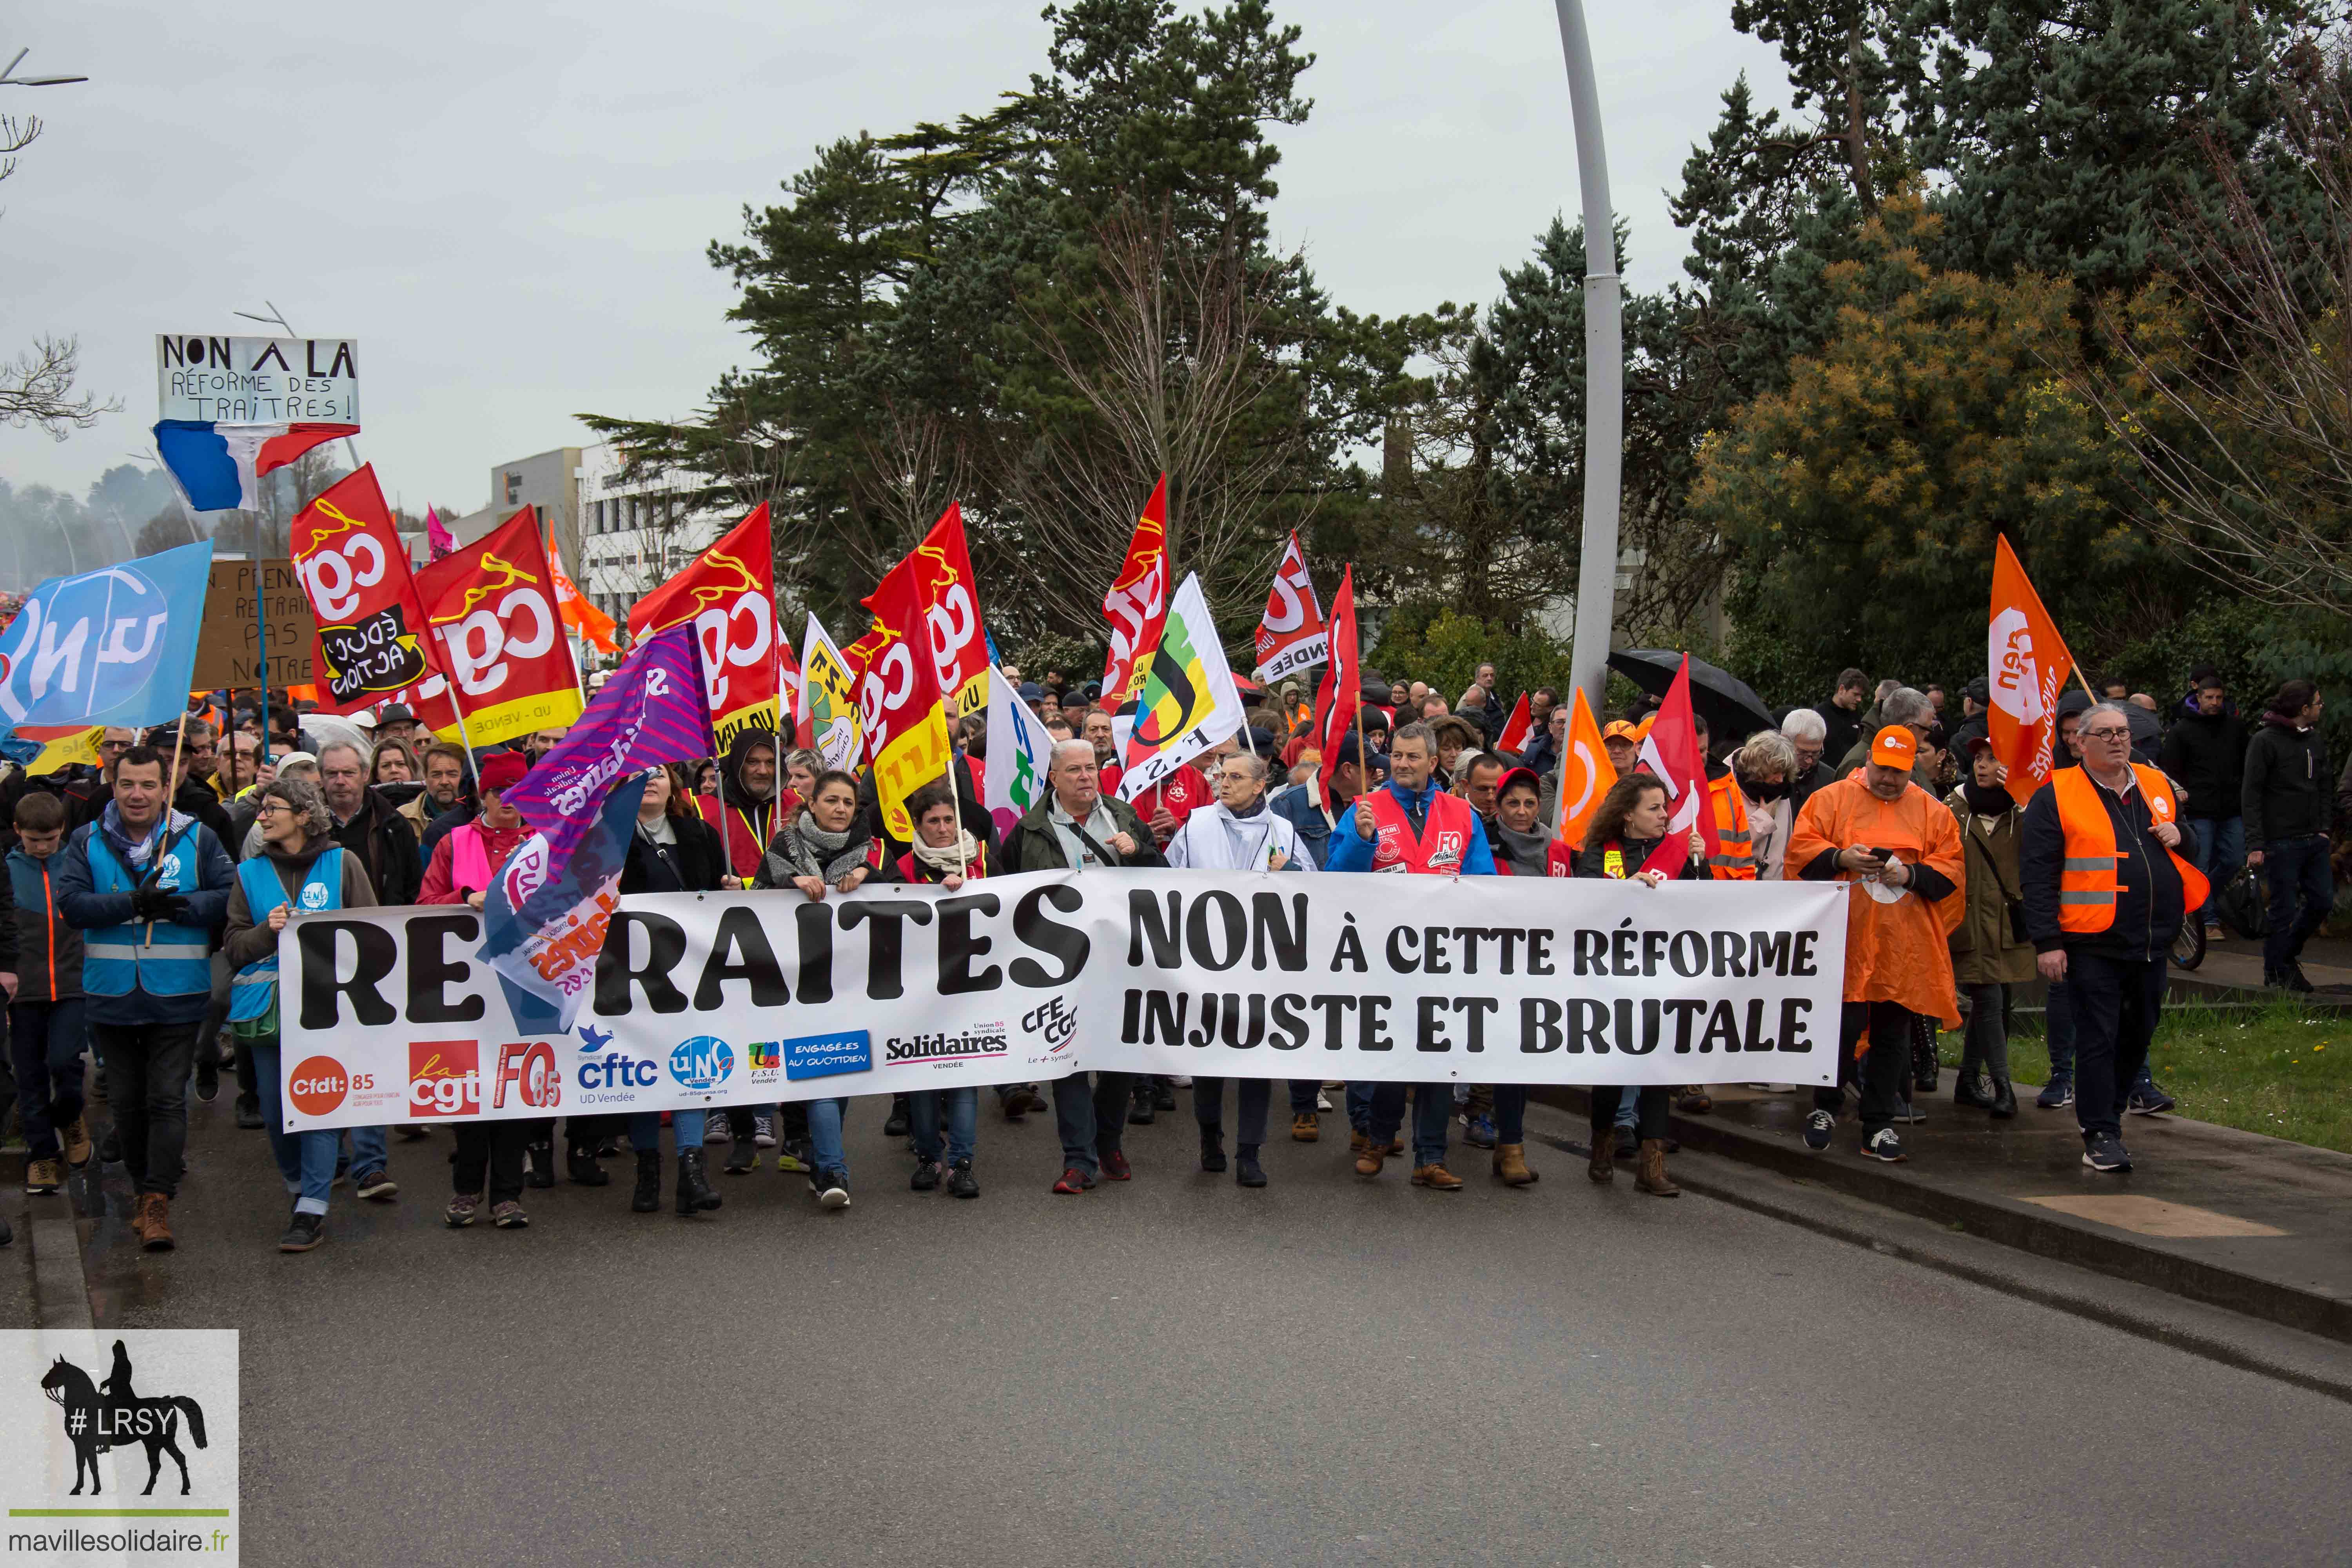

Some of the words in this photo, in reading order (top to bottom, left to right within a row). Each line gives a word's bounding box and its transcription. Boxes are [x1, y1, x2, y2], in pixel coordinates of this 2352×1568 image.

[163, 336, 231, 370] NON
[307, 340, 356, 378] LA
[172, 368, 272, 396] RÉFORME
[289, 377, 331, 392] DES
[245, 623, 298, 649] PAS
[1170, 787, 1185, 797] cgt
[1377, 826, 1397, 835] MPLOI
[1437, 831, 1462, 852] FO
[1552, 861, 1566, 877] FO
[1128, 889, 1308, 972] NON
[1330, 911, 1368, 973] À
[1385, 926, 1555, 975] CETTE
[1573, 917, 1818, 978] RÉFORME
[296, 884, 1090, 1030] RERAITES
[1022, 995, 1063, 1033] CFE
[1044, 1005, 1077, 1043] CGC
[1121, 989, 1394, 1051] INJUSTE
[1416, 996, 1498, 1053] ET
[1520, 998, 1812, 1055] BRUTALE
[795, 1042, 859, 1053] ENGAGÉ-ES
[886, 1031, 1007, 1060] Solidaires
[413, 1054, 479, 1079] la
[578, 1053, 658, 1089] cftc
[807, 1054, 866, 1066] QUOTIDIEN
[293, 1076, 344, 1095] Cfdt:
[352, 1074, 374, 1090] 85
[493, 1042, 555, 1109] FO
[751, 1069, 779, 1078] F.S.U.
[410, 1070, 480, 1113] cgt
[533, 1070, 561, 1108] 85
[580, 1094, 595, 1103] UD
[598, 1092, 635, 1103] Vendée
[679, 1089, 727, 1097] ud-85@unsa.org
